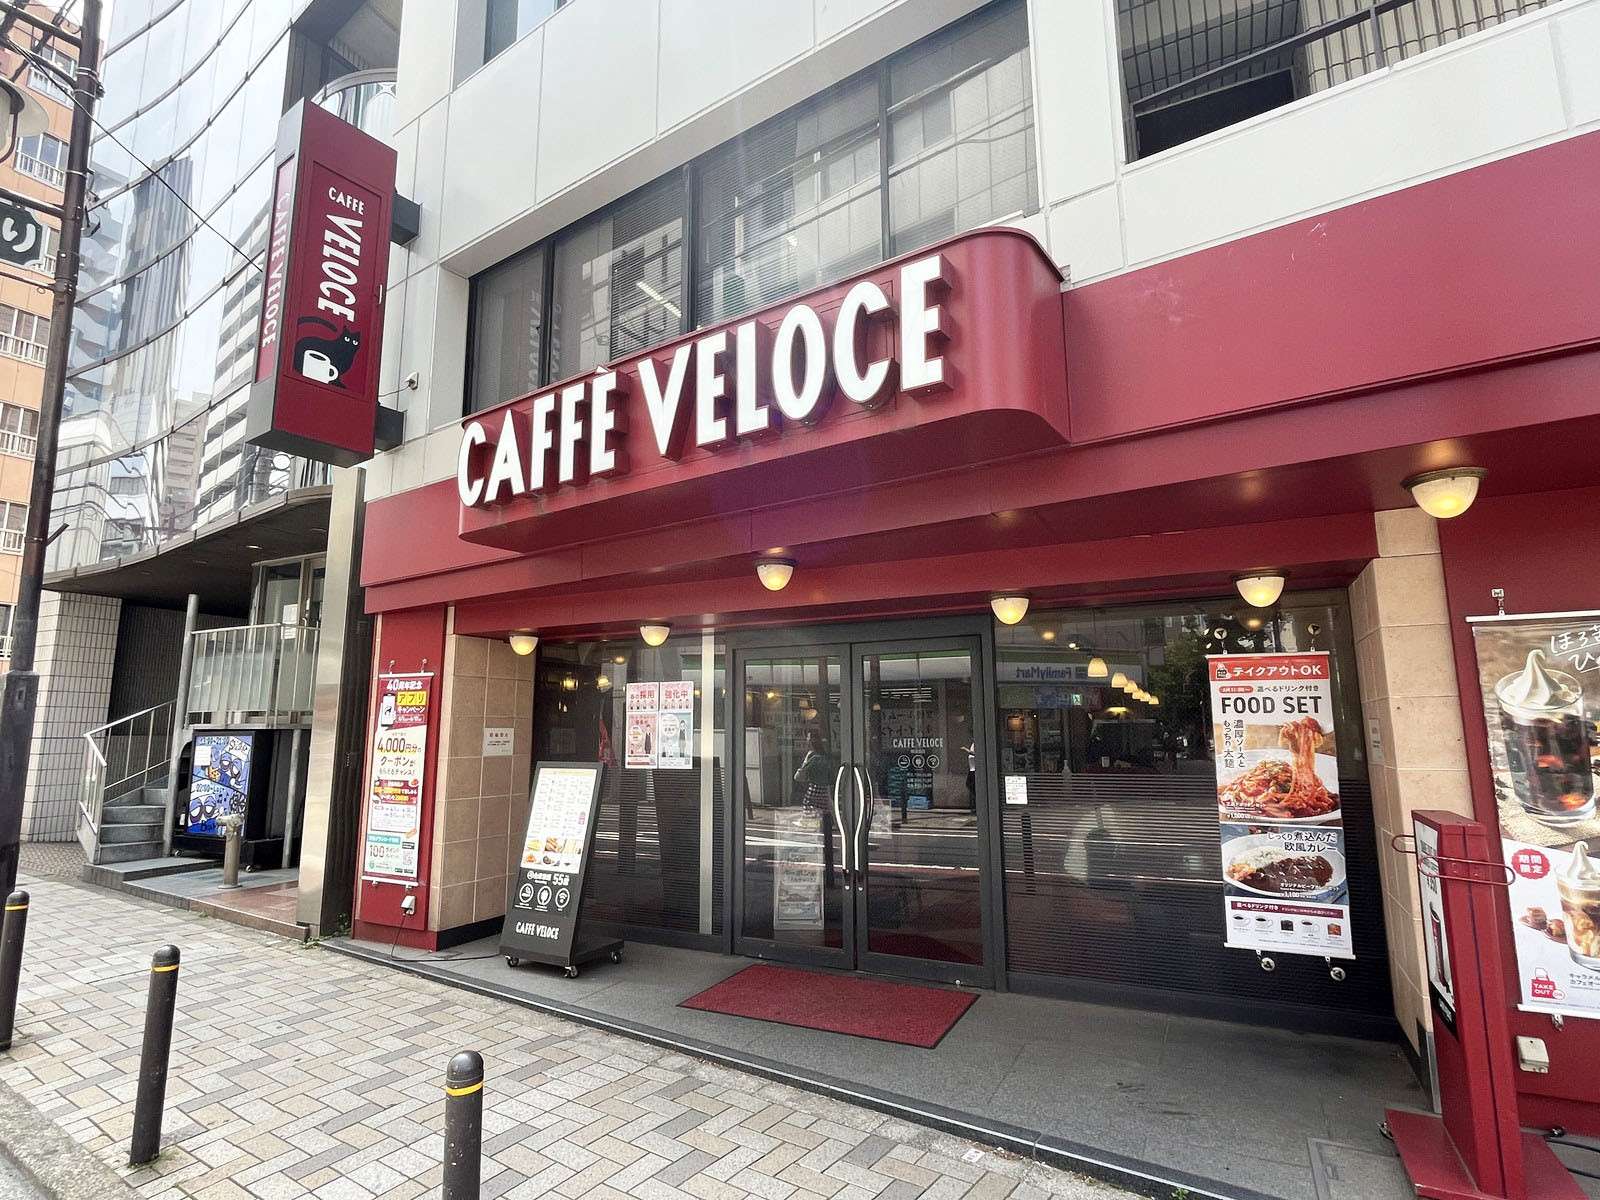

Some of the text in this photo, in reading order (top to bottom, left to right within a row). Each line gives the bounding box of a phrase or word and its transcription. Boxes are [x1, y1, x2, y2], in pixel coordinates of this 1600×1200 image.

[317, 214, 363, 323] VELOCE
[262, 262, 284, 348] VELOCE
[637, 253, 945, 458] VELOCE
[1233, 665, 1322, 676] テイクアウトOK
[398, 693, 426, 704] アプリ
[1221, 695, 1322, 714] FOOD SET
[916, 737, 943, 748] VELOCE
[1233, 719, 1245, 768] 濃厚ソースと
[380, 756, 416, 767] クーポンが
[1267, 831, 1338, 843] じっくり煮込んだ
[1284, 842, 1337, 852] 欧風カレー
[1518, 854, 1543, 864] 期間
[536, 924, 560, 940] VELOCE
[1533, 983, 1554, 991] TAKE
